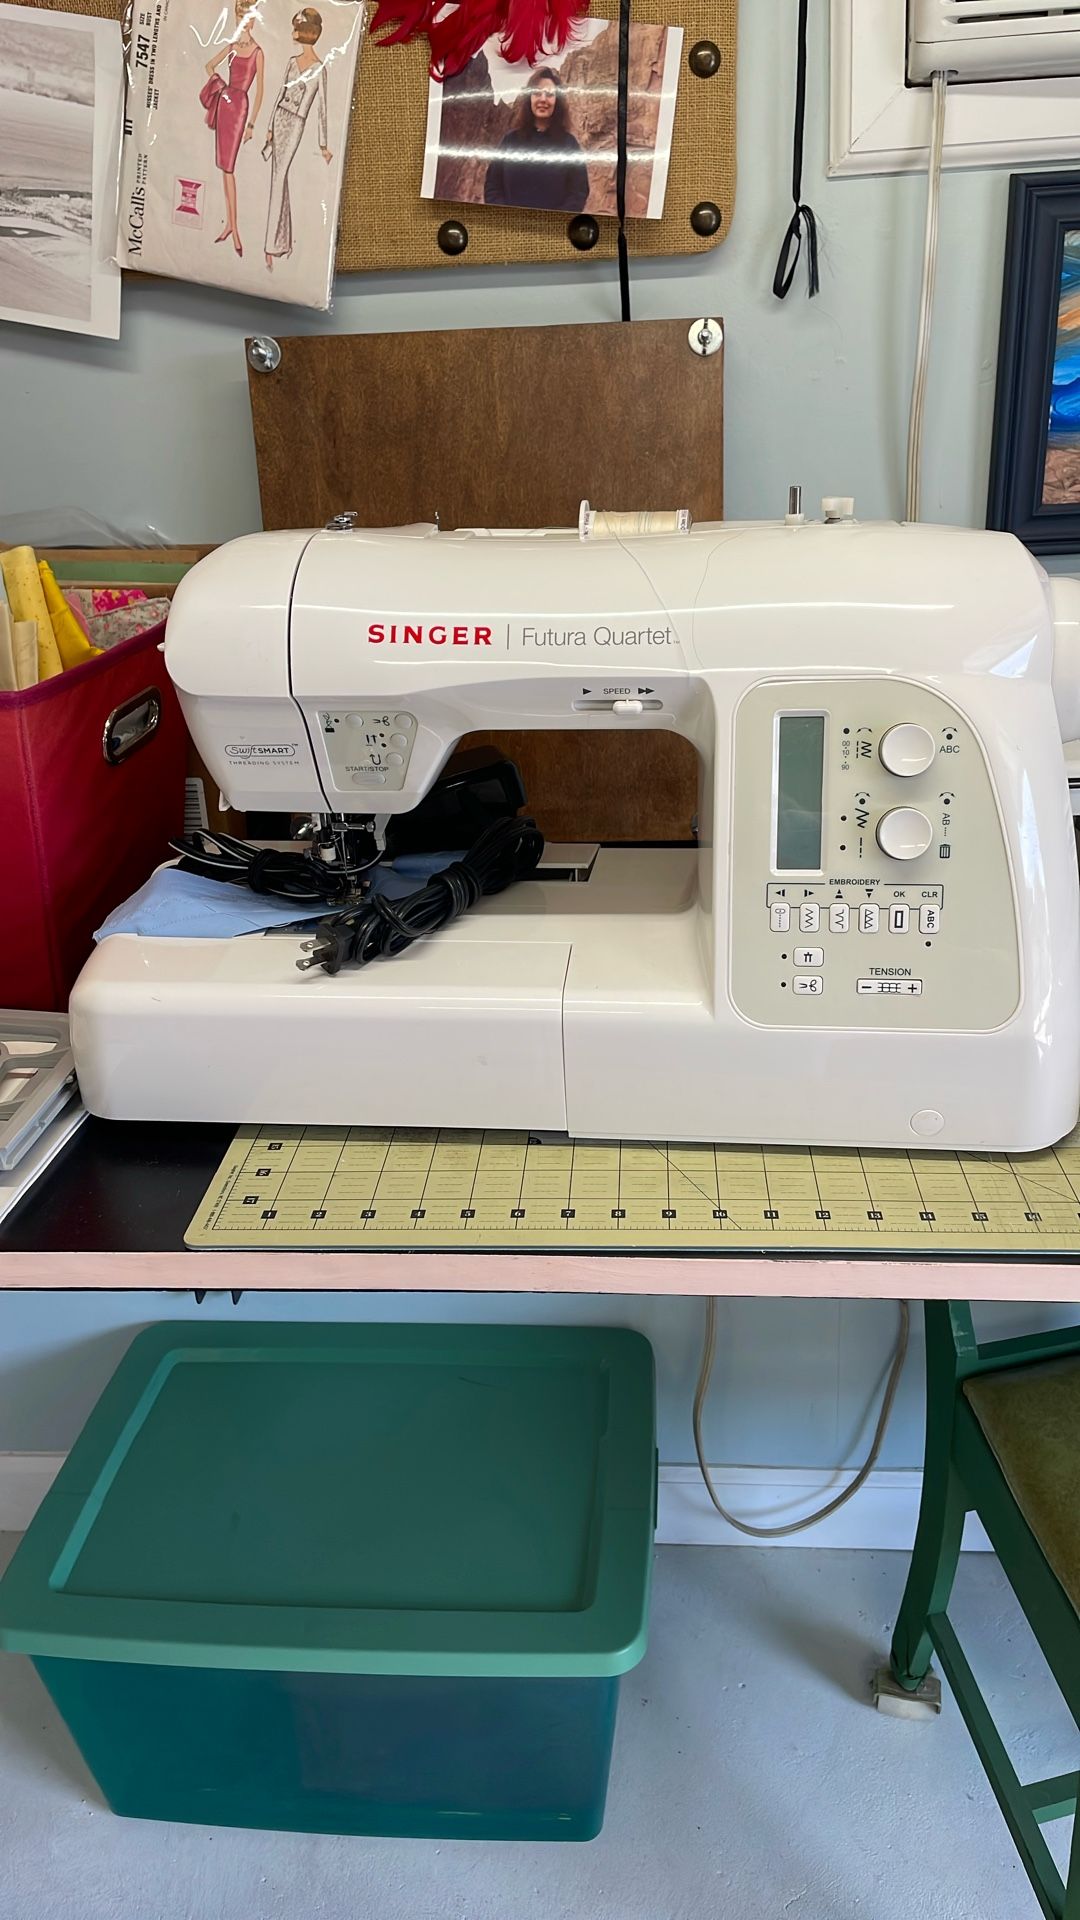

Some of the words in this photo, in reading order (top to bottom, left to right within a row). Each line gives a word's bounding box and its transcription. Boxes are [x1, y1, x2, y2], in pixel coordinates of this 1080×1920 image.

[152, 18, 160, 43] LENGTHS
[135, 34, 150, 68] 7547
[152, 89, 160, 110] JACKET
[128, 186, 146, 256] McCall's
[367, 624, 492, 645] SINGER
[522, 627, 587, 646] Futura
[939, 745, 960, 753] ABC
[926, 909, 935, 929] ABC
[869, 968, 912, 976] TENSION
